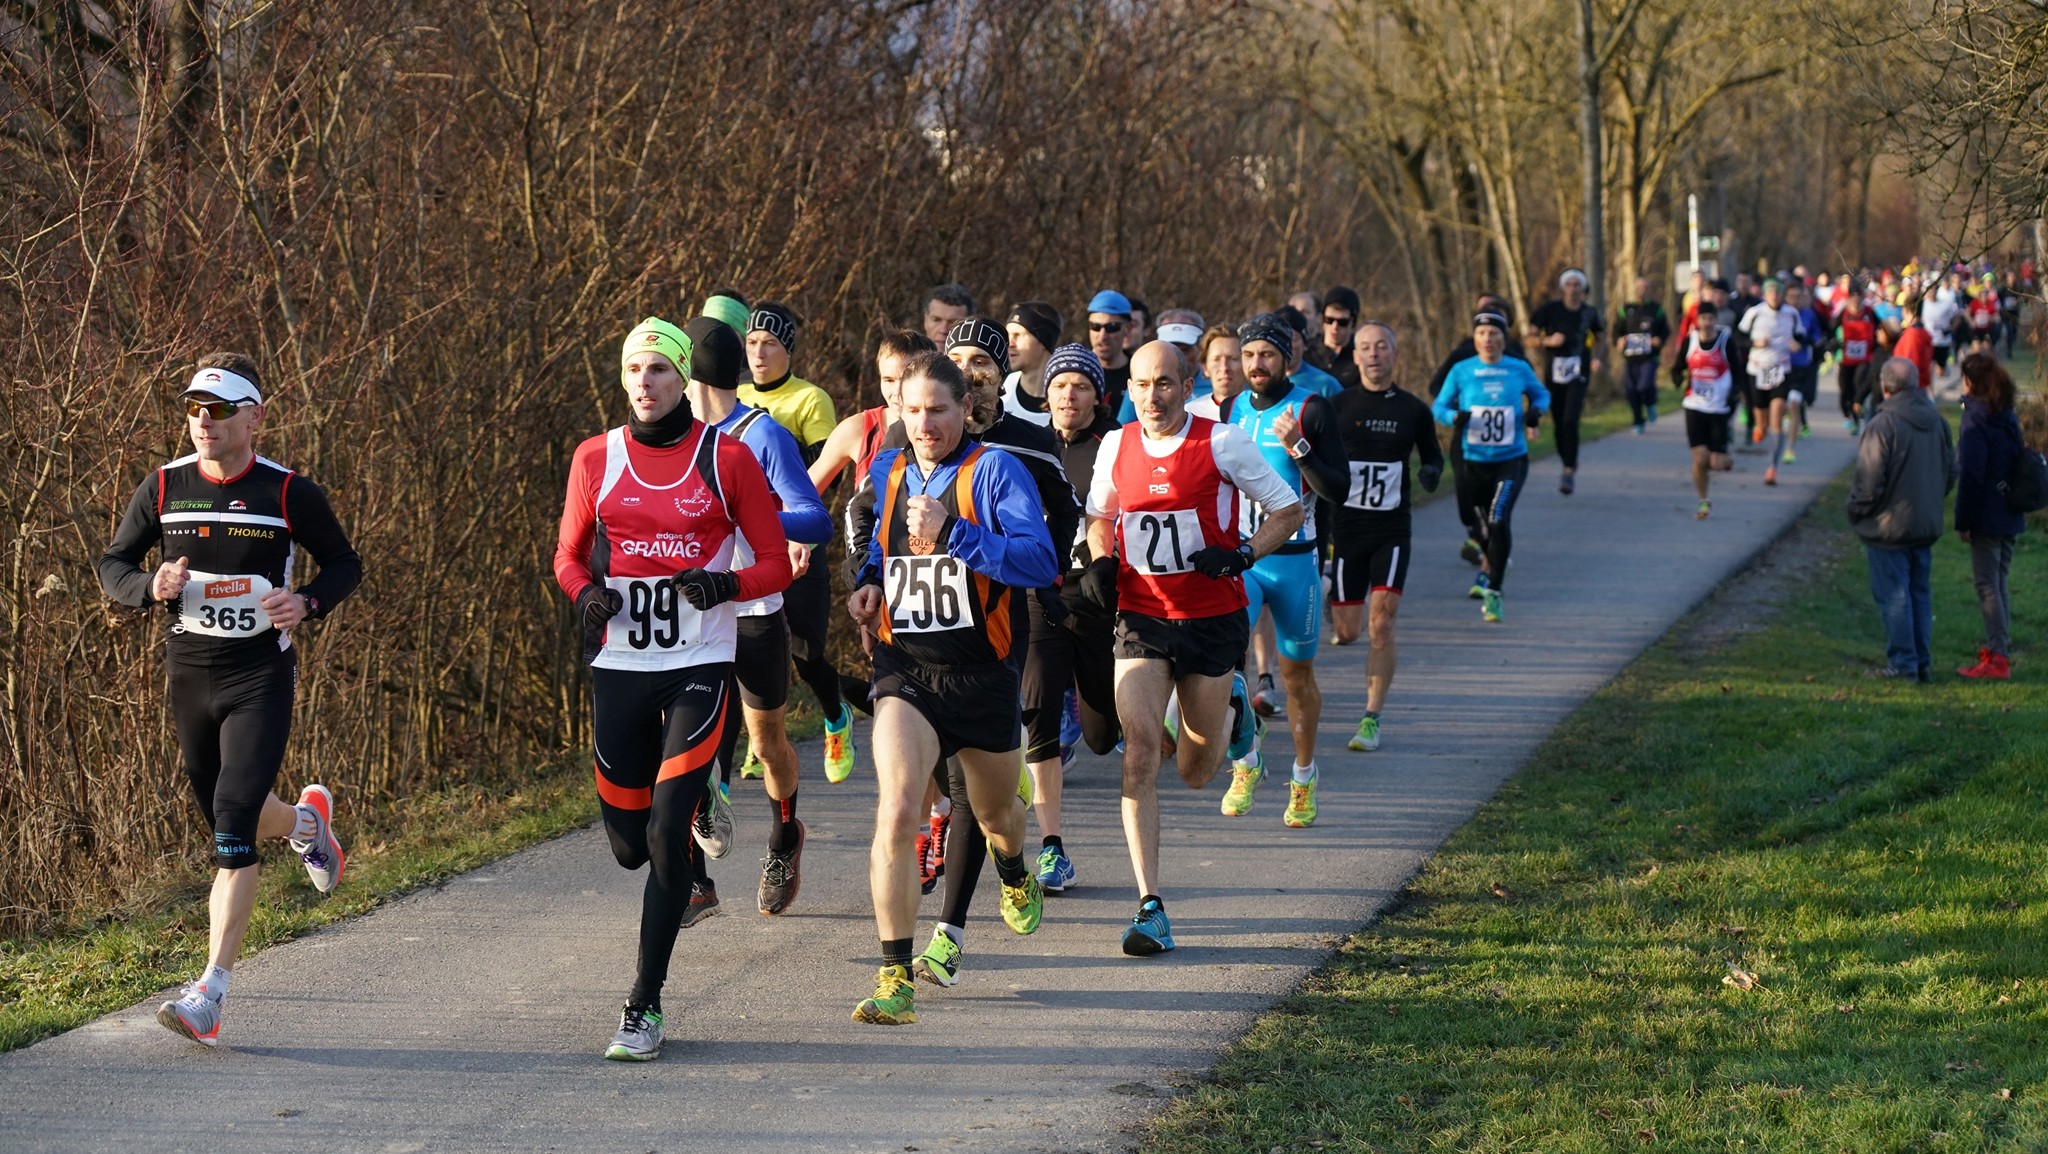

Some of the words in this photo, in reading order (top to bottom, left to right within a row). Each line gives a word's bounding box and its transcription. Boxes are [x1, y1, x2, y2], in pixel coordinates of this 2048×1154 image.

[1365, 419, 1398, 427] SPORT
[1481, 410, 1504, 443] 39
[1359, 465, 1388, 508] 15
[227, 527, 275, 539] THOMAS
[656, 532, 683, 541] erdgas
[620, 540, 702, 558] GRAVAG
[1140, 514, 1185, 572] 21
[210, 581, 246, 595] rivella
[889, 557, 960, 629] 256
[199, 605, 257, 631] 365
[694, 684, 712, 693] asics
